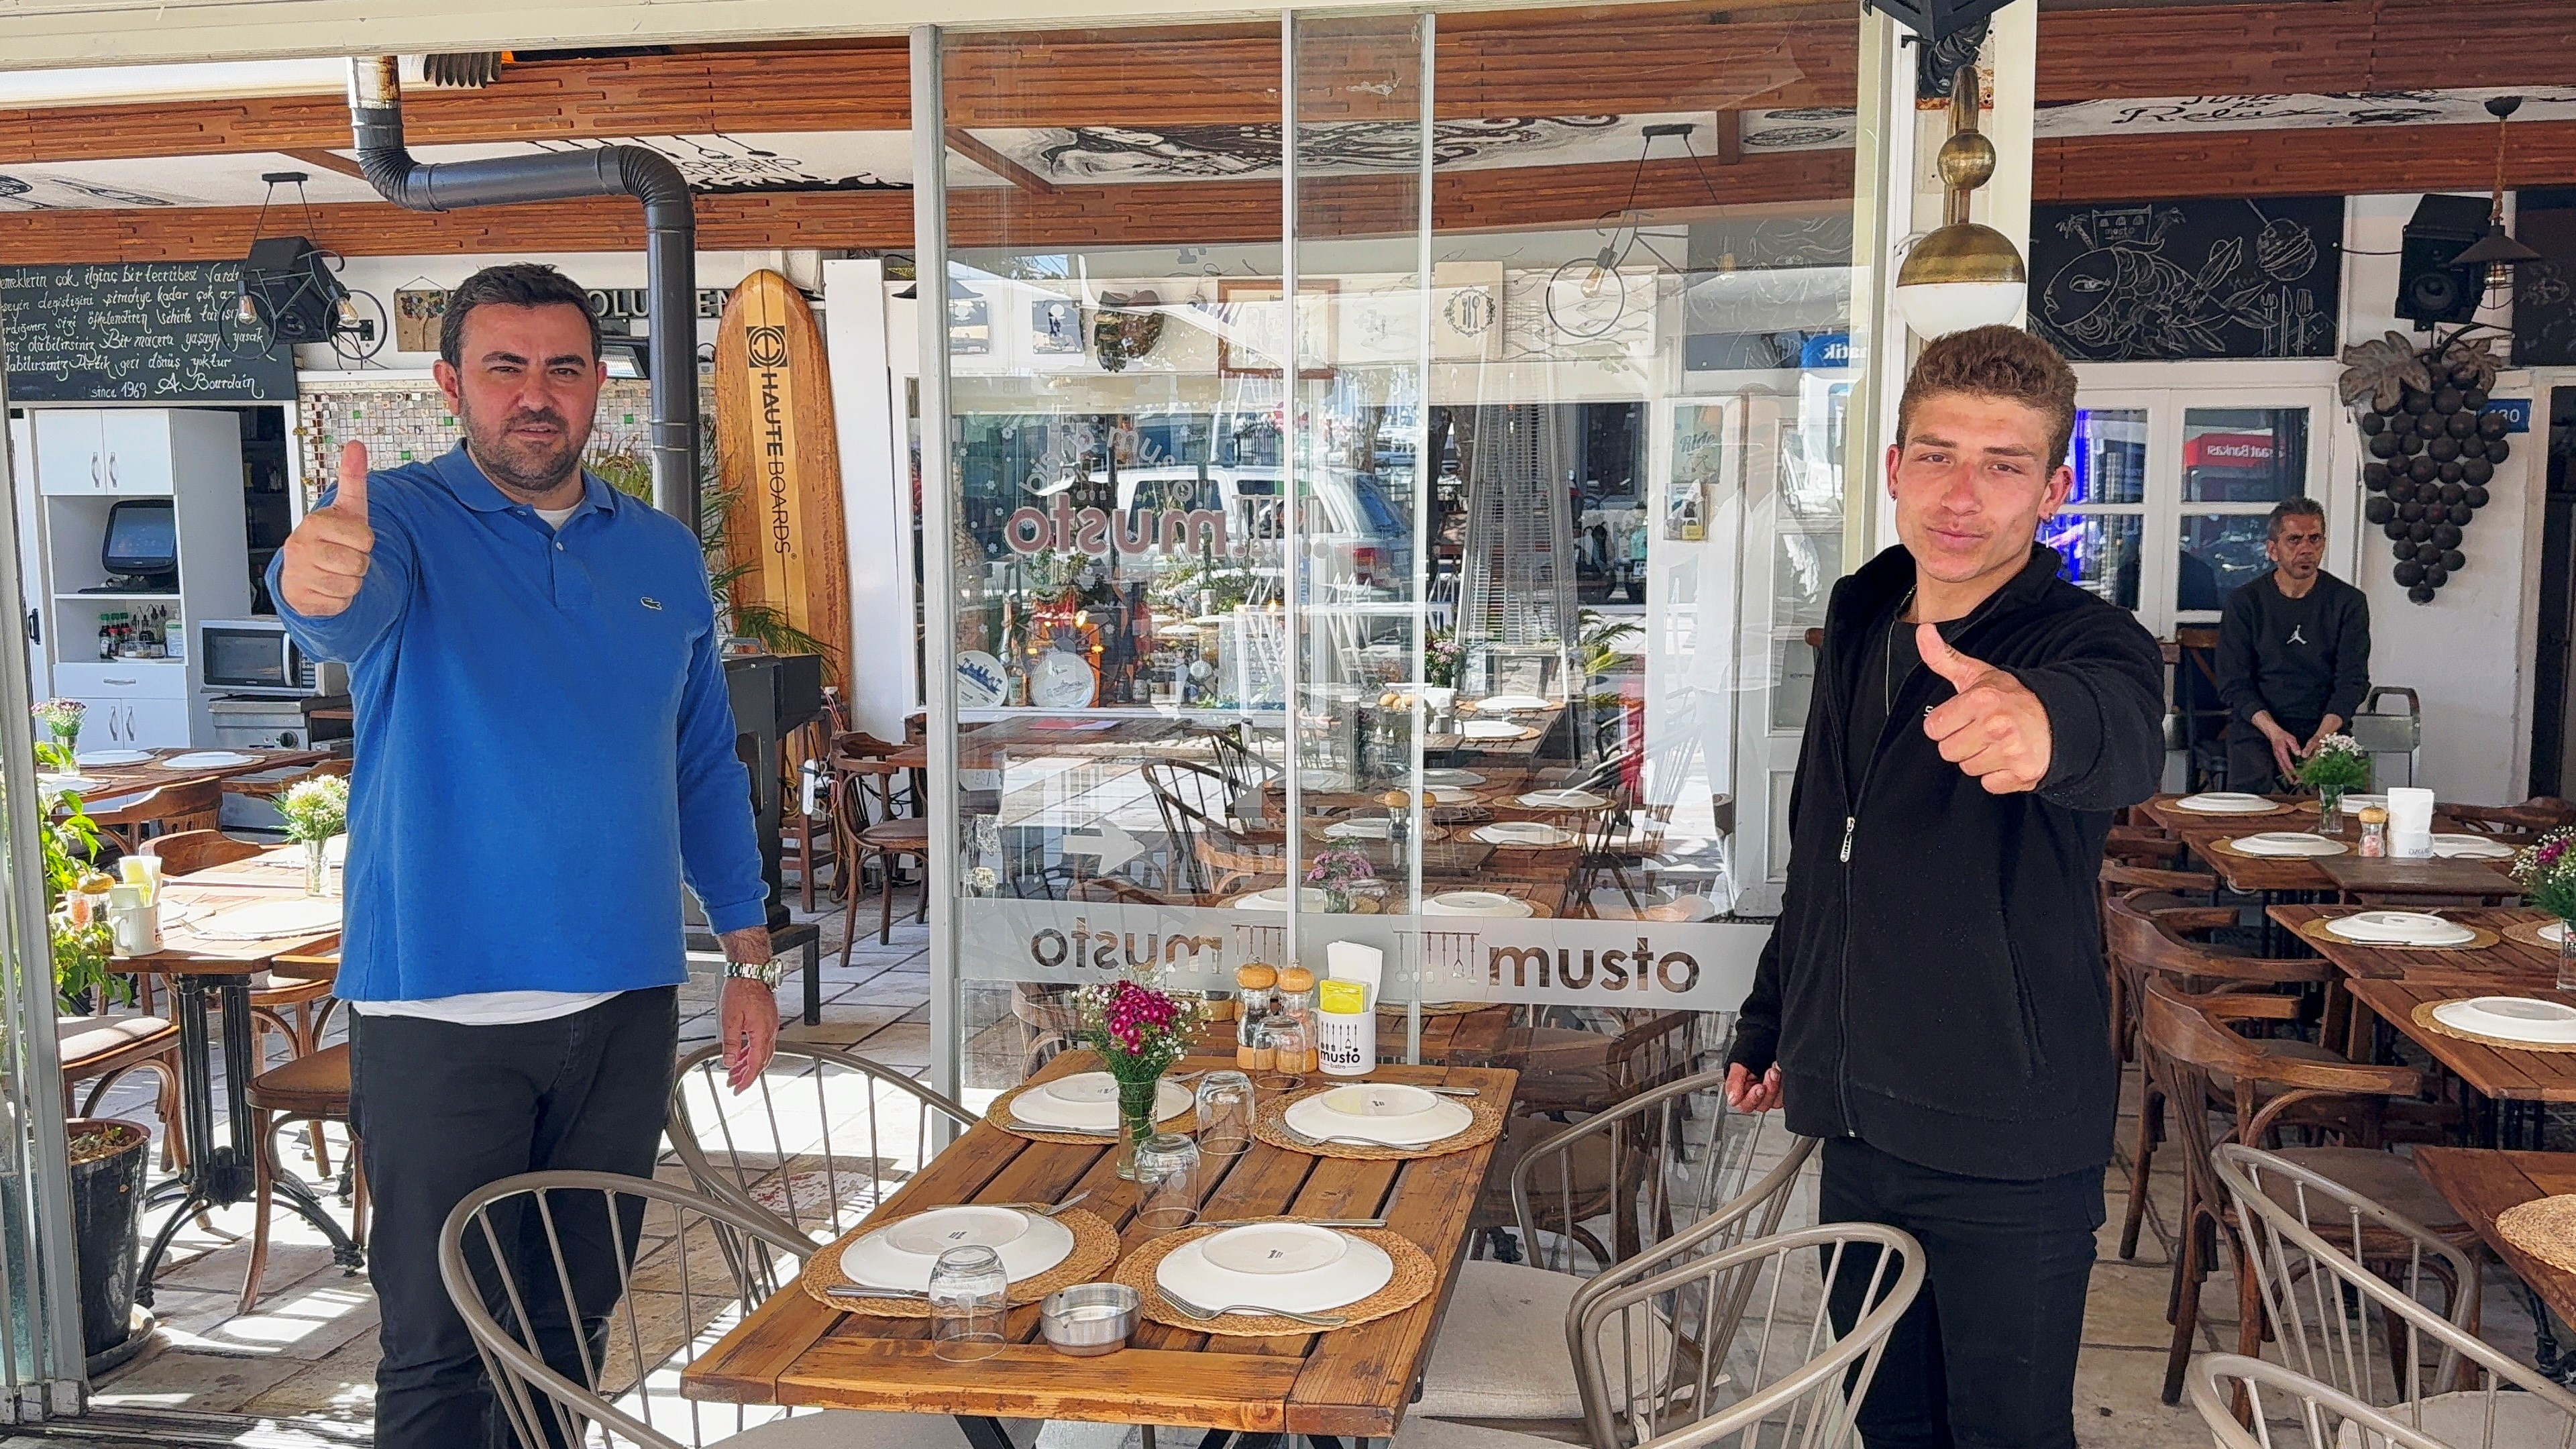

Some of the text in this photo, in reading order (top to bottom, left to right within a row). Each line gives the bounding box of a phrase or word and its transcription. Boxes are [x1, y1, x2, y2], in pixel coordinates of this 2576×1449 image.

[2111, 105, 2339, 124] Relax
[0, 268, 47, 289] emeklerin
[157, 285, 189, 308] kadar
[121, 381, 147, 398] 1969
[1679, 431, 1716, 453] Ride
[1489, 936, 1701, 993] musto
[1320, 1050, 1360, 1064] musto
